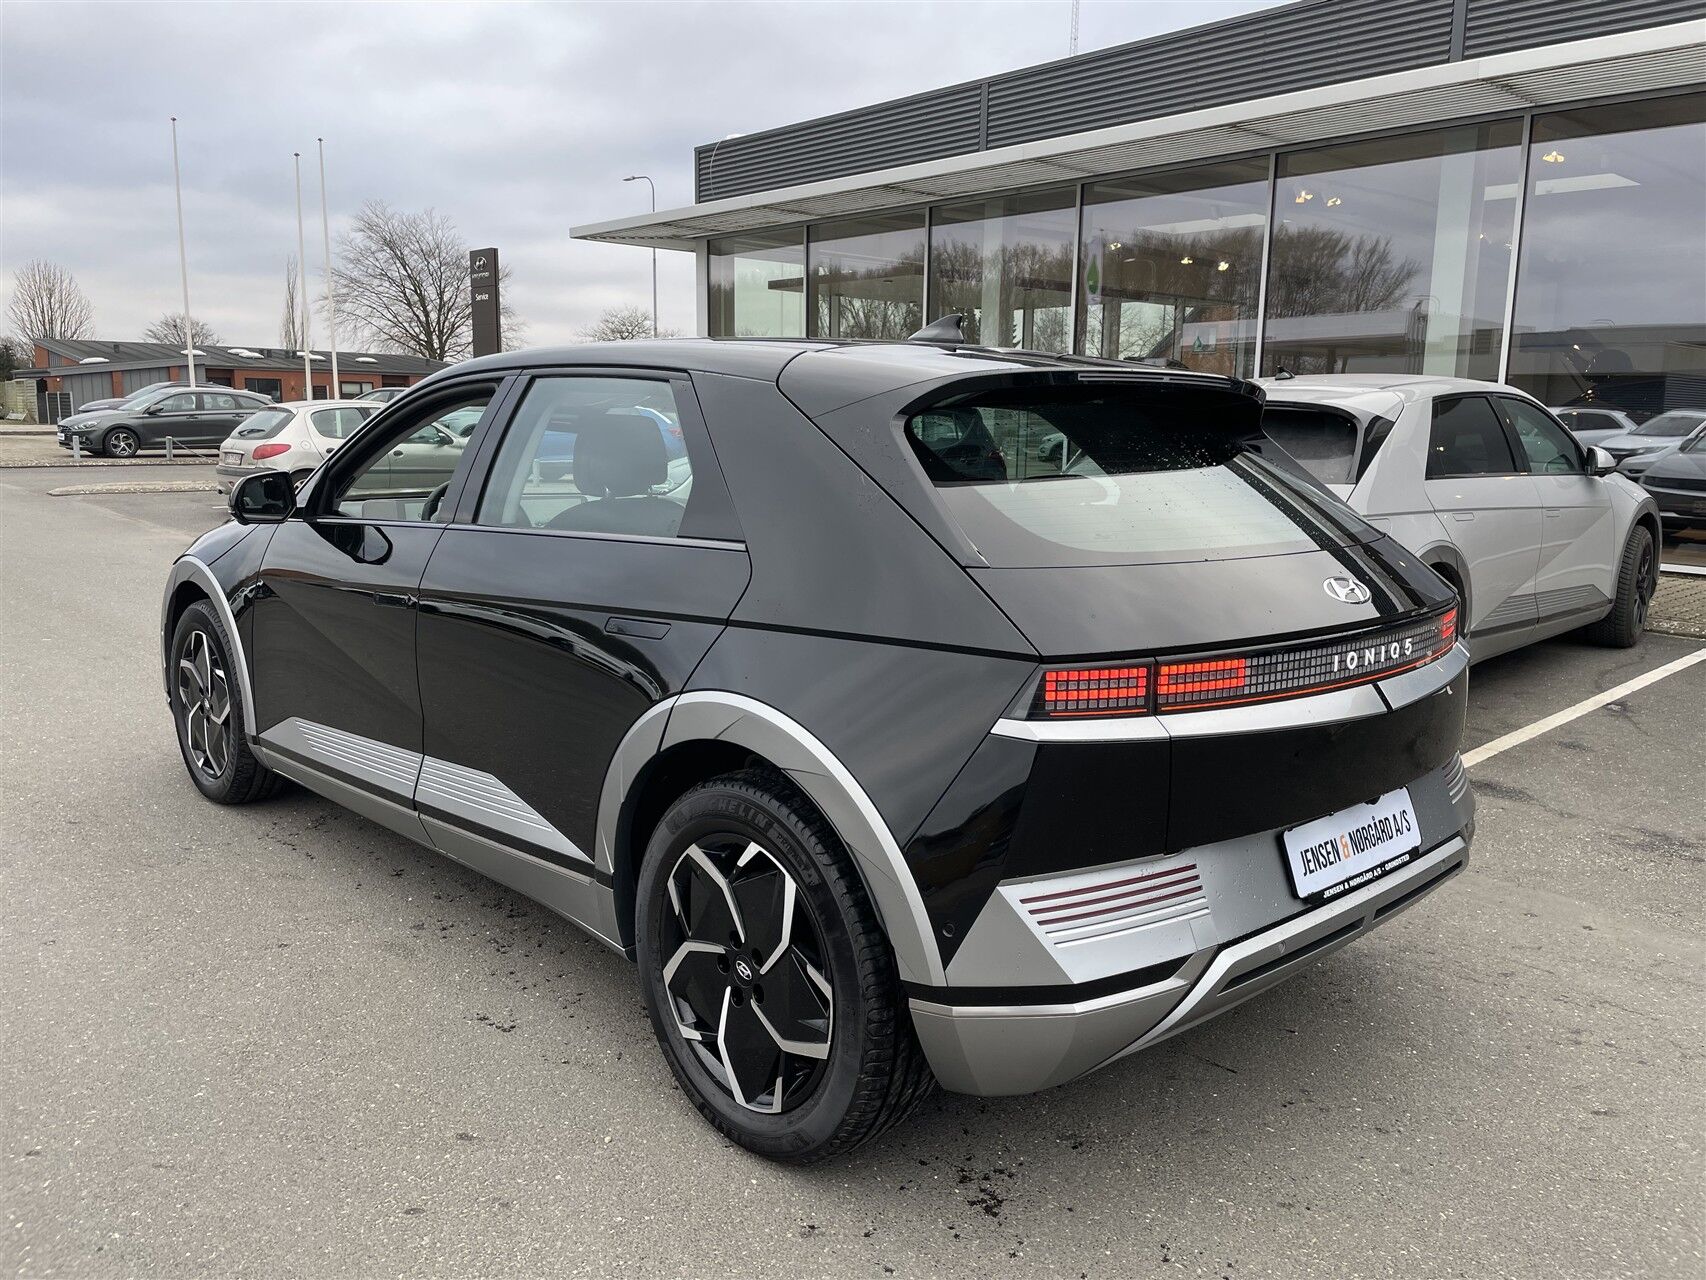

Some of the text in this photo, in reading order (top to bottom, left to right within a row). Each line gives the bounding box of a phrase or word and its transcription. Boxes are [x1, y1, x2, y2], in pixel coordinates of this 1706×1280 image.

[1300, 809, 1411, 877] JENSEN & NØRGÅRD A/S
[1323, 883, 1344, 898] JENSEN
